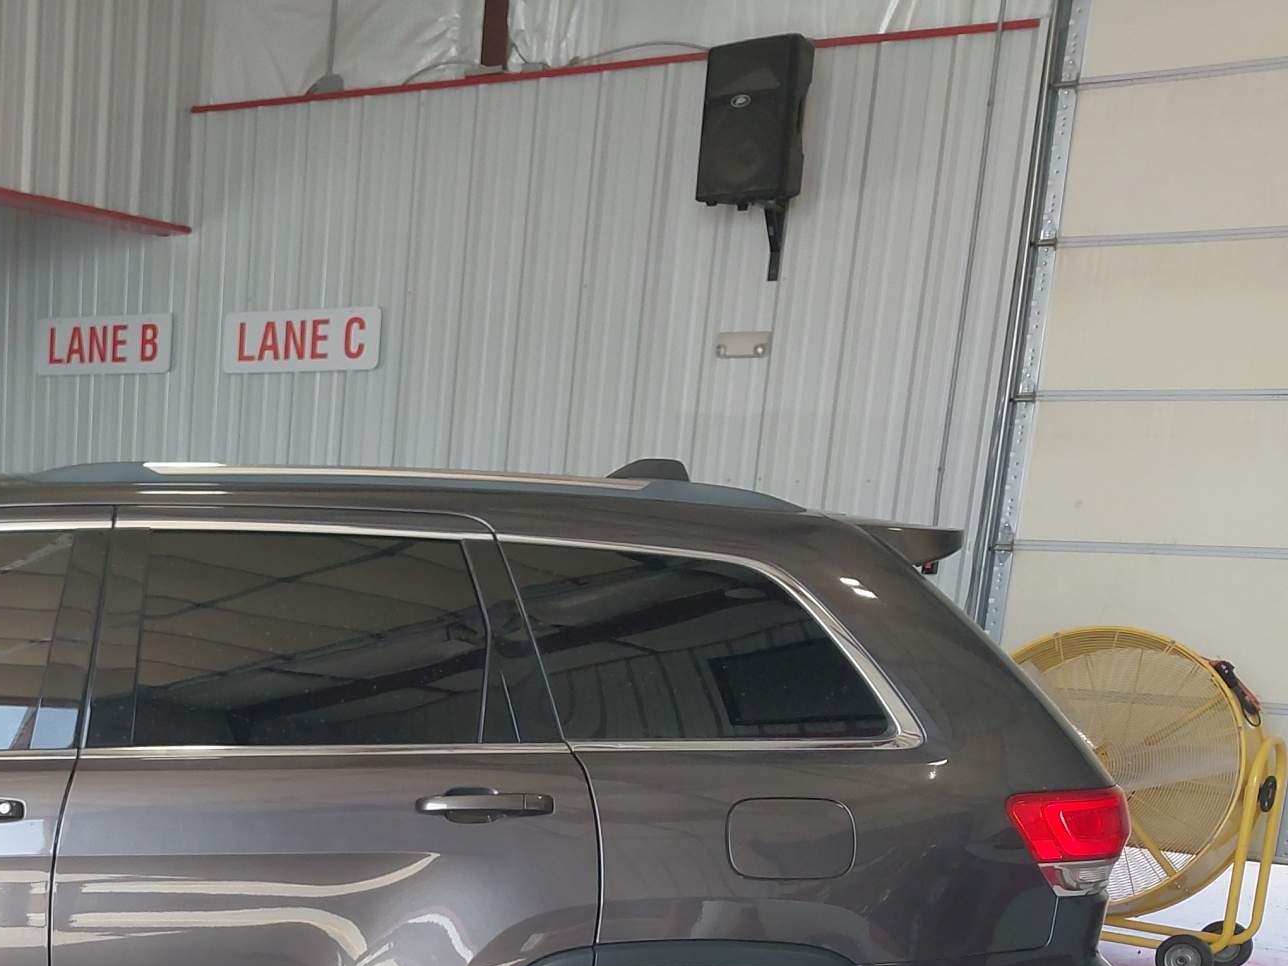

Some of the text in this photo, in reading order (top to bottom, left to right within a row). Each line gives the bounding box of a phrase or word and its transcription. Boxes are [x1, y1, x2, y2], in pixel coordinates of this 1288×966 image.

[47, 322, 159, 365] LANE B
[236, 315, 366, 363] LANE C
